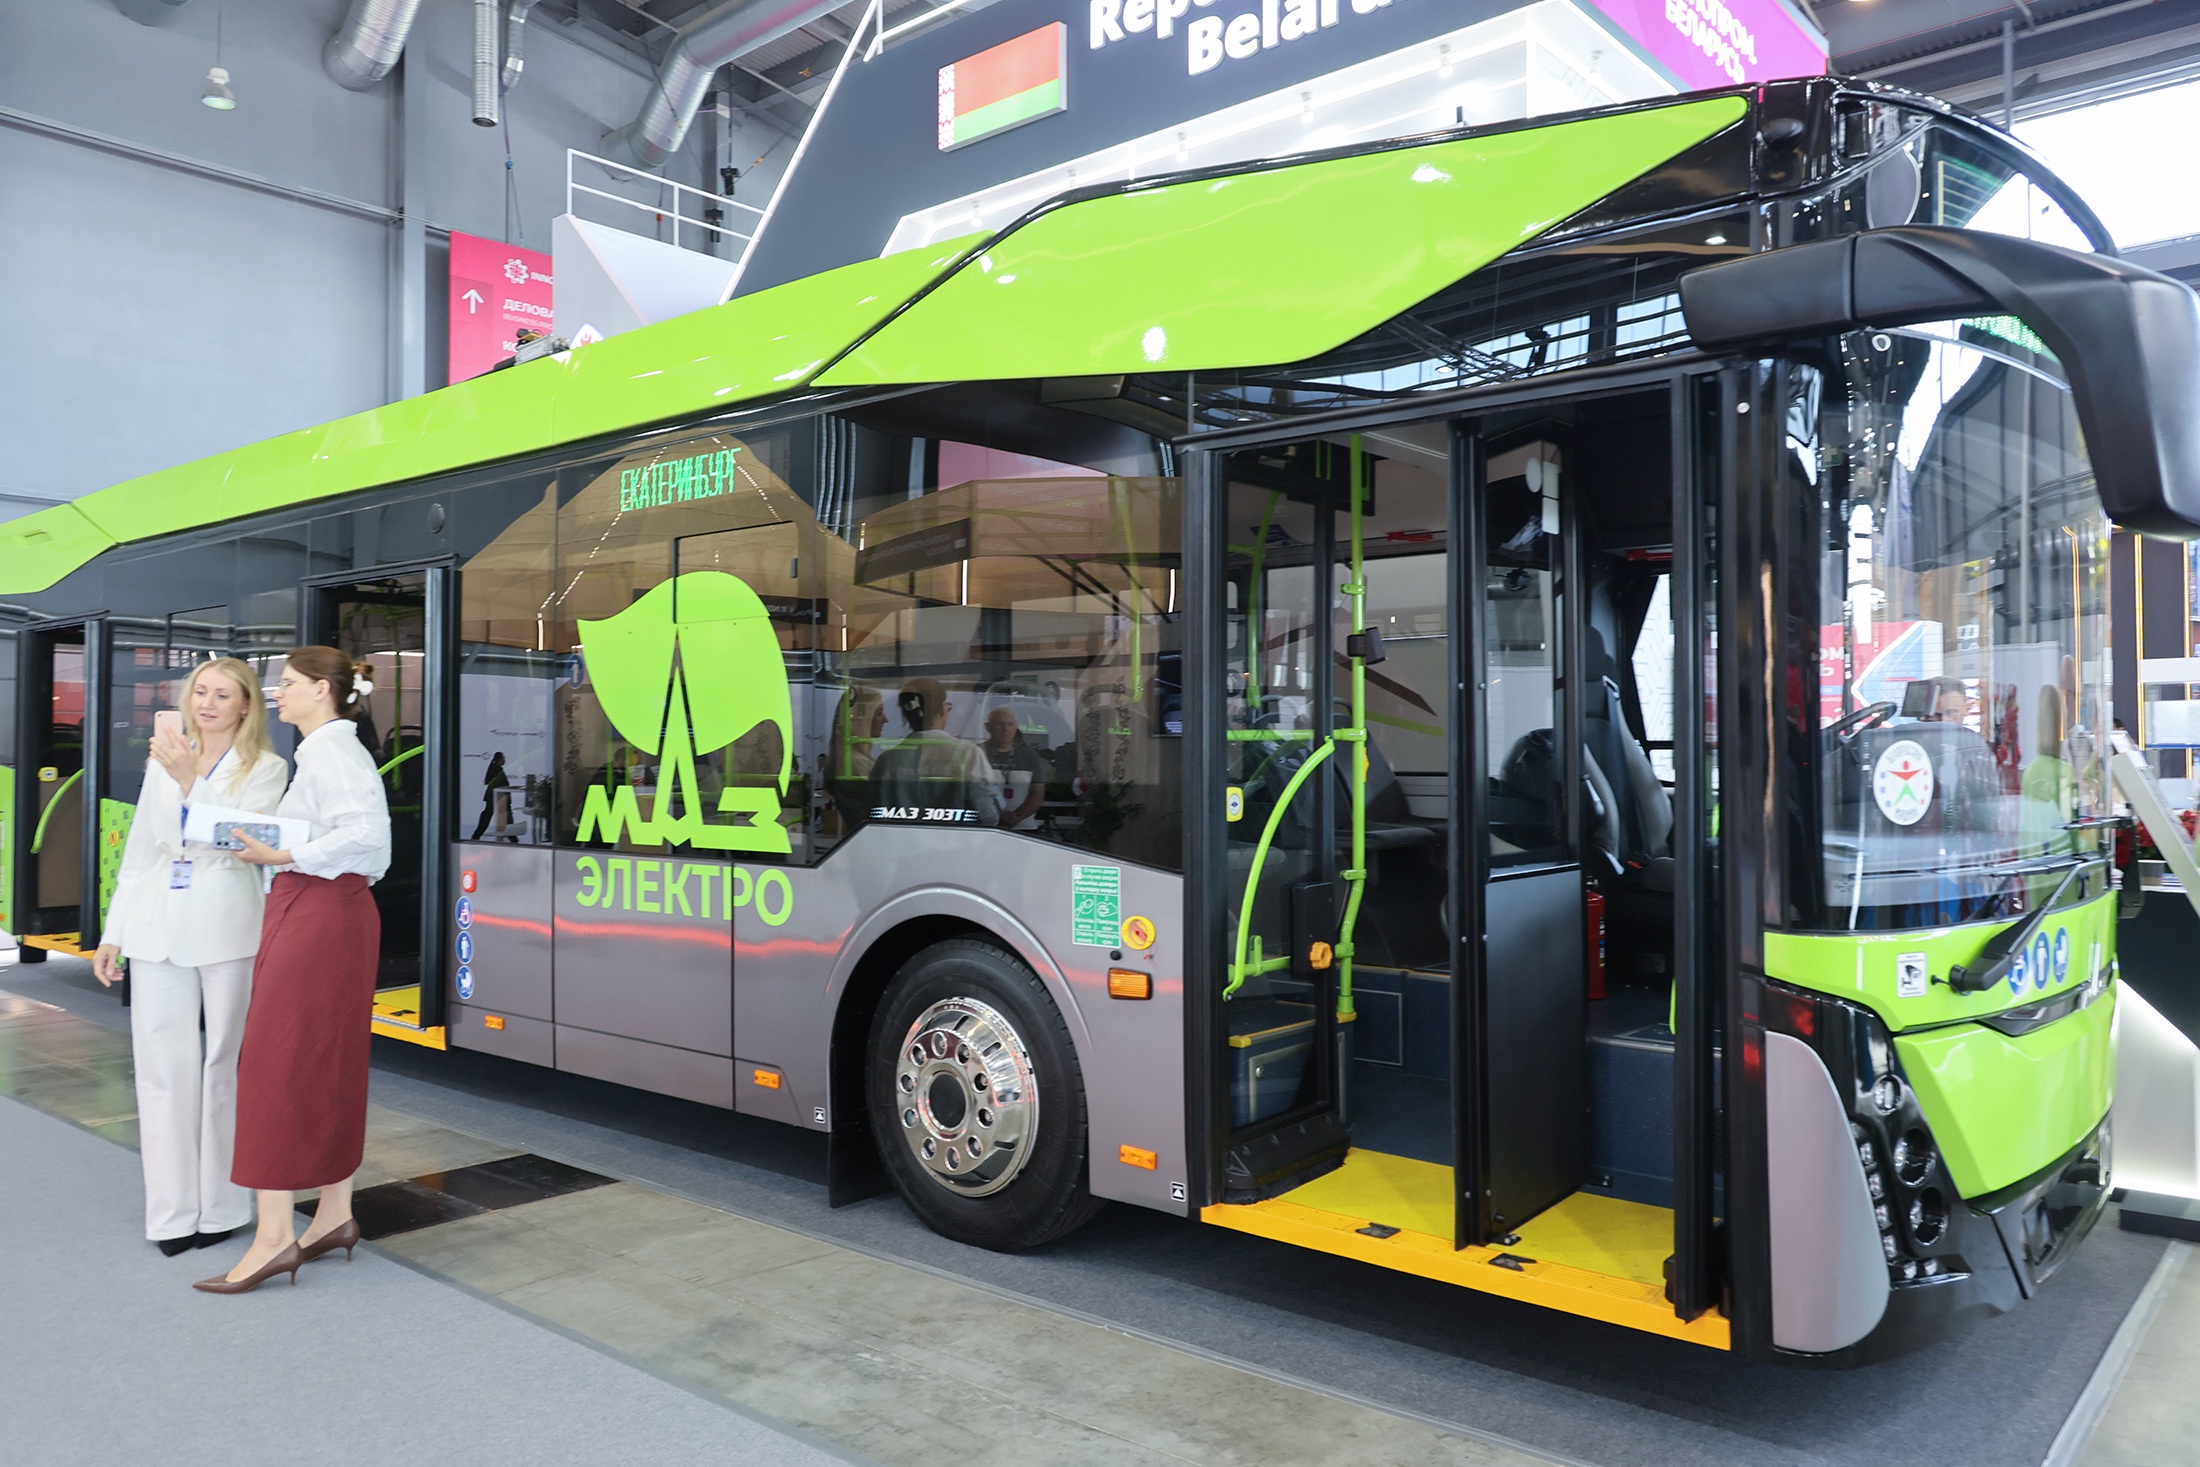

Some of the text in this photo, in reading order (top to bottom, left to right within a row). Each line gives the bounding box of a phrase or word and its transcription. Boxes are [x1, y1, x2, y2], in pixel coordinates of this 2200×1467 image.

[1665, 0, 1746, 84] БЕЛАРУСЬ
[620, 447, 742, 512] ЕКАТЕРИНБУРГ
[881, 806, 920, 819] МАЗ
[575, 855, 794, 927] ЭЛЕКТРО
